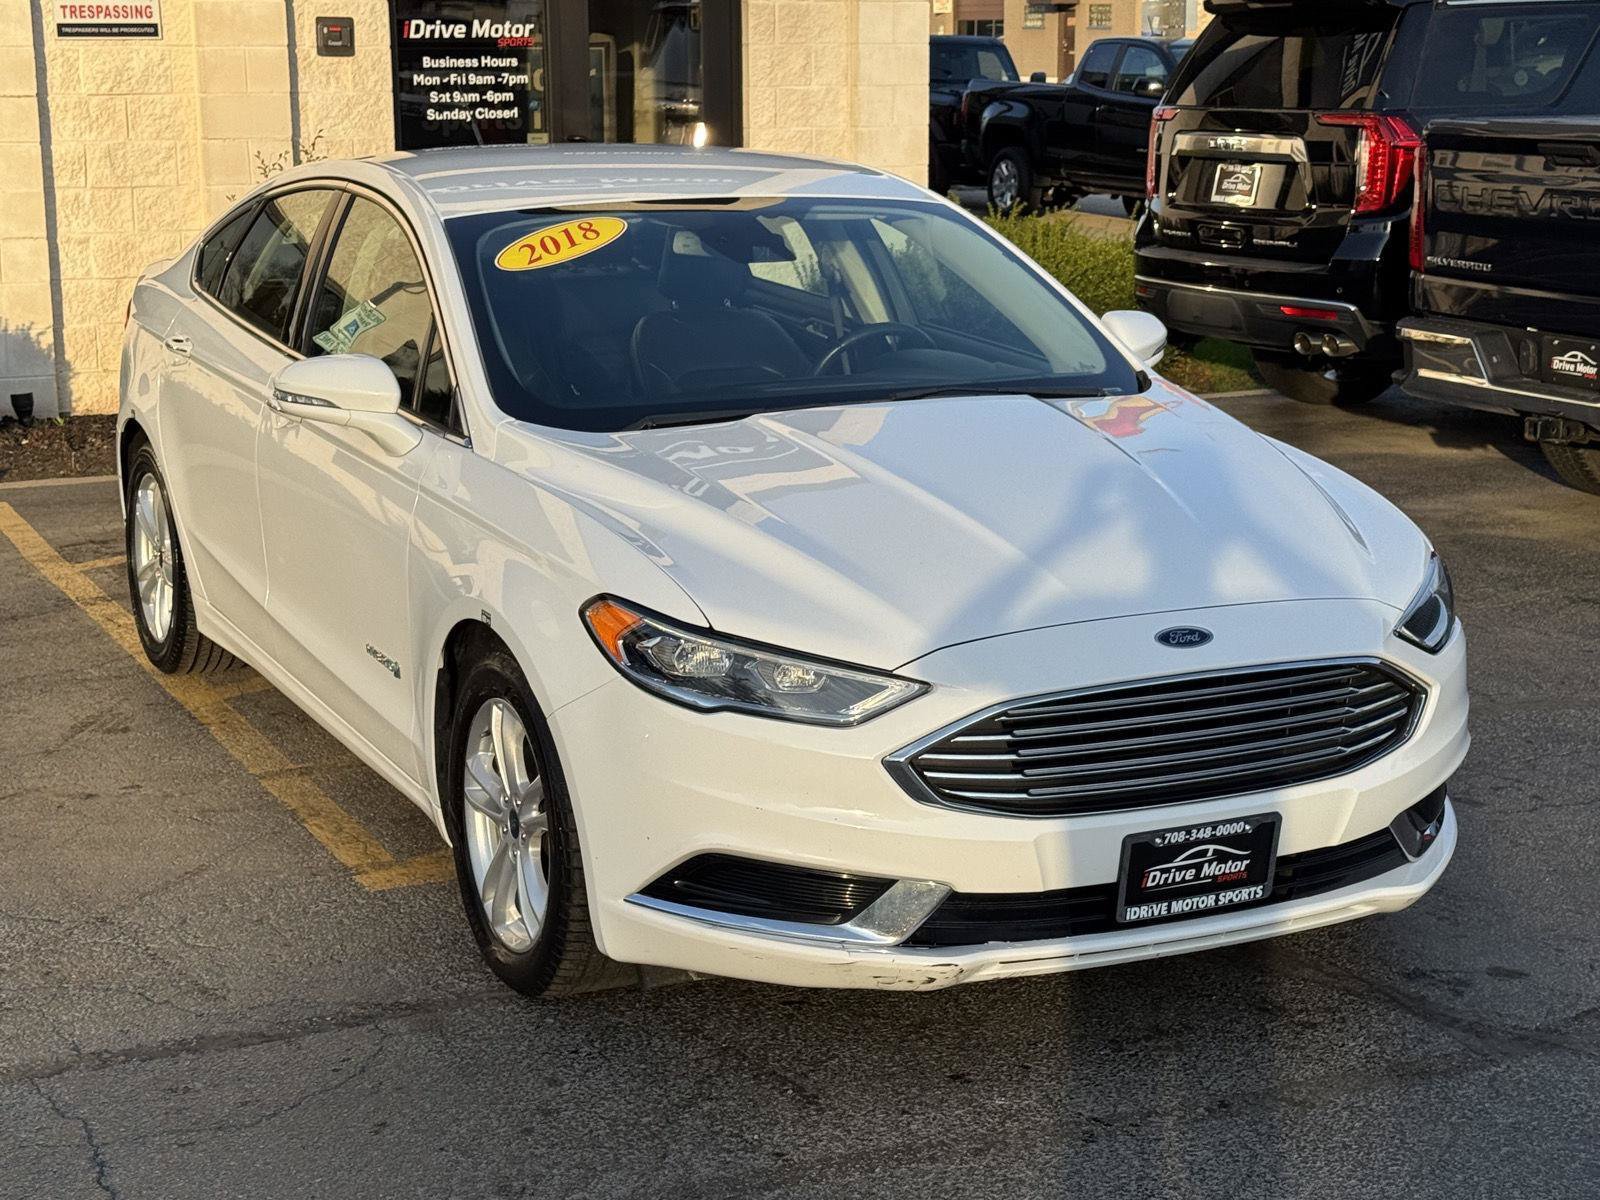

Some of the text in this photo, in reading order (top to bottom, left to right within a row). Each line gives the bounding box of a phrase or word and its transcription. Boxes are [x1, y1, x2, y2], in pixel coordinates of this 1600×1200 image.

[60, 5, 154, 19] TRESPASSING
[403, 18, 535, 39] iDrive Motor
[497, 37, 536, 47] SPORTS
[422, 56, 518, 68] Business Hours
[413, 74, 440, 86] Mon
[468, 73, 495, 85] 9am
[429, 91, 451, 103] Sat
[452, 91, 480, 103] 9am
[426, 107, 518, 122] Sunday Closed
[518, 221, 600, 266] 2018
[1576, 363, 1598, 375] Motor
[1169, 630, 1201, 643] Ford
[1164, 821, 1245, 845] 708-348-0000
[1140, 859, 1251, 890] iDrive Motor
[1216, 871, 1248, 884] SPORTS
[1170, 893, 1216, 914] MOTOR
[1218, 885, 1264, 905] SPORTS
